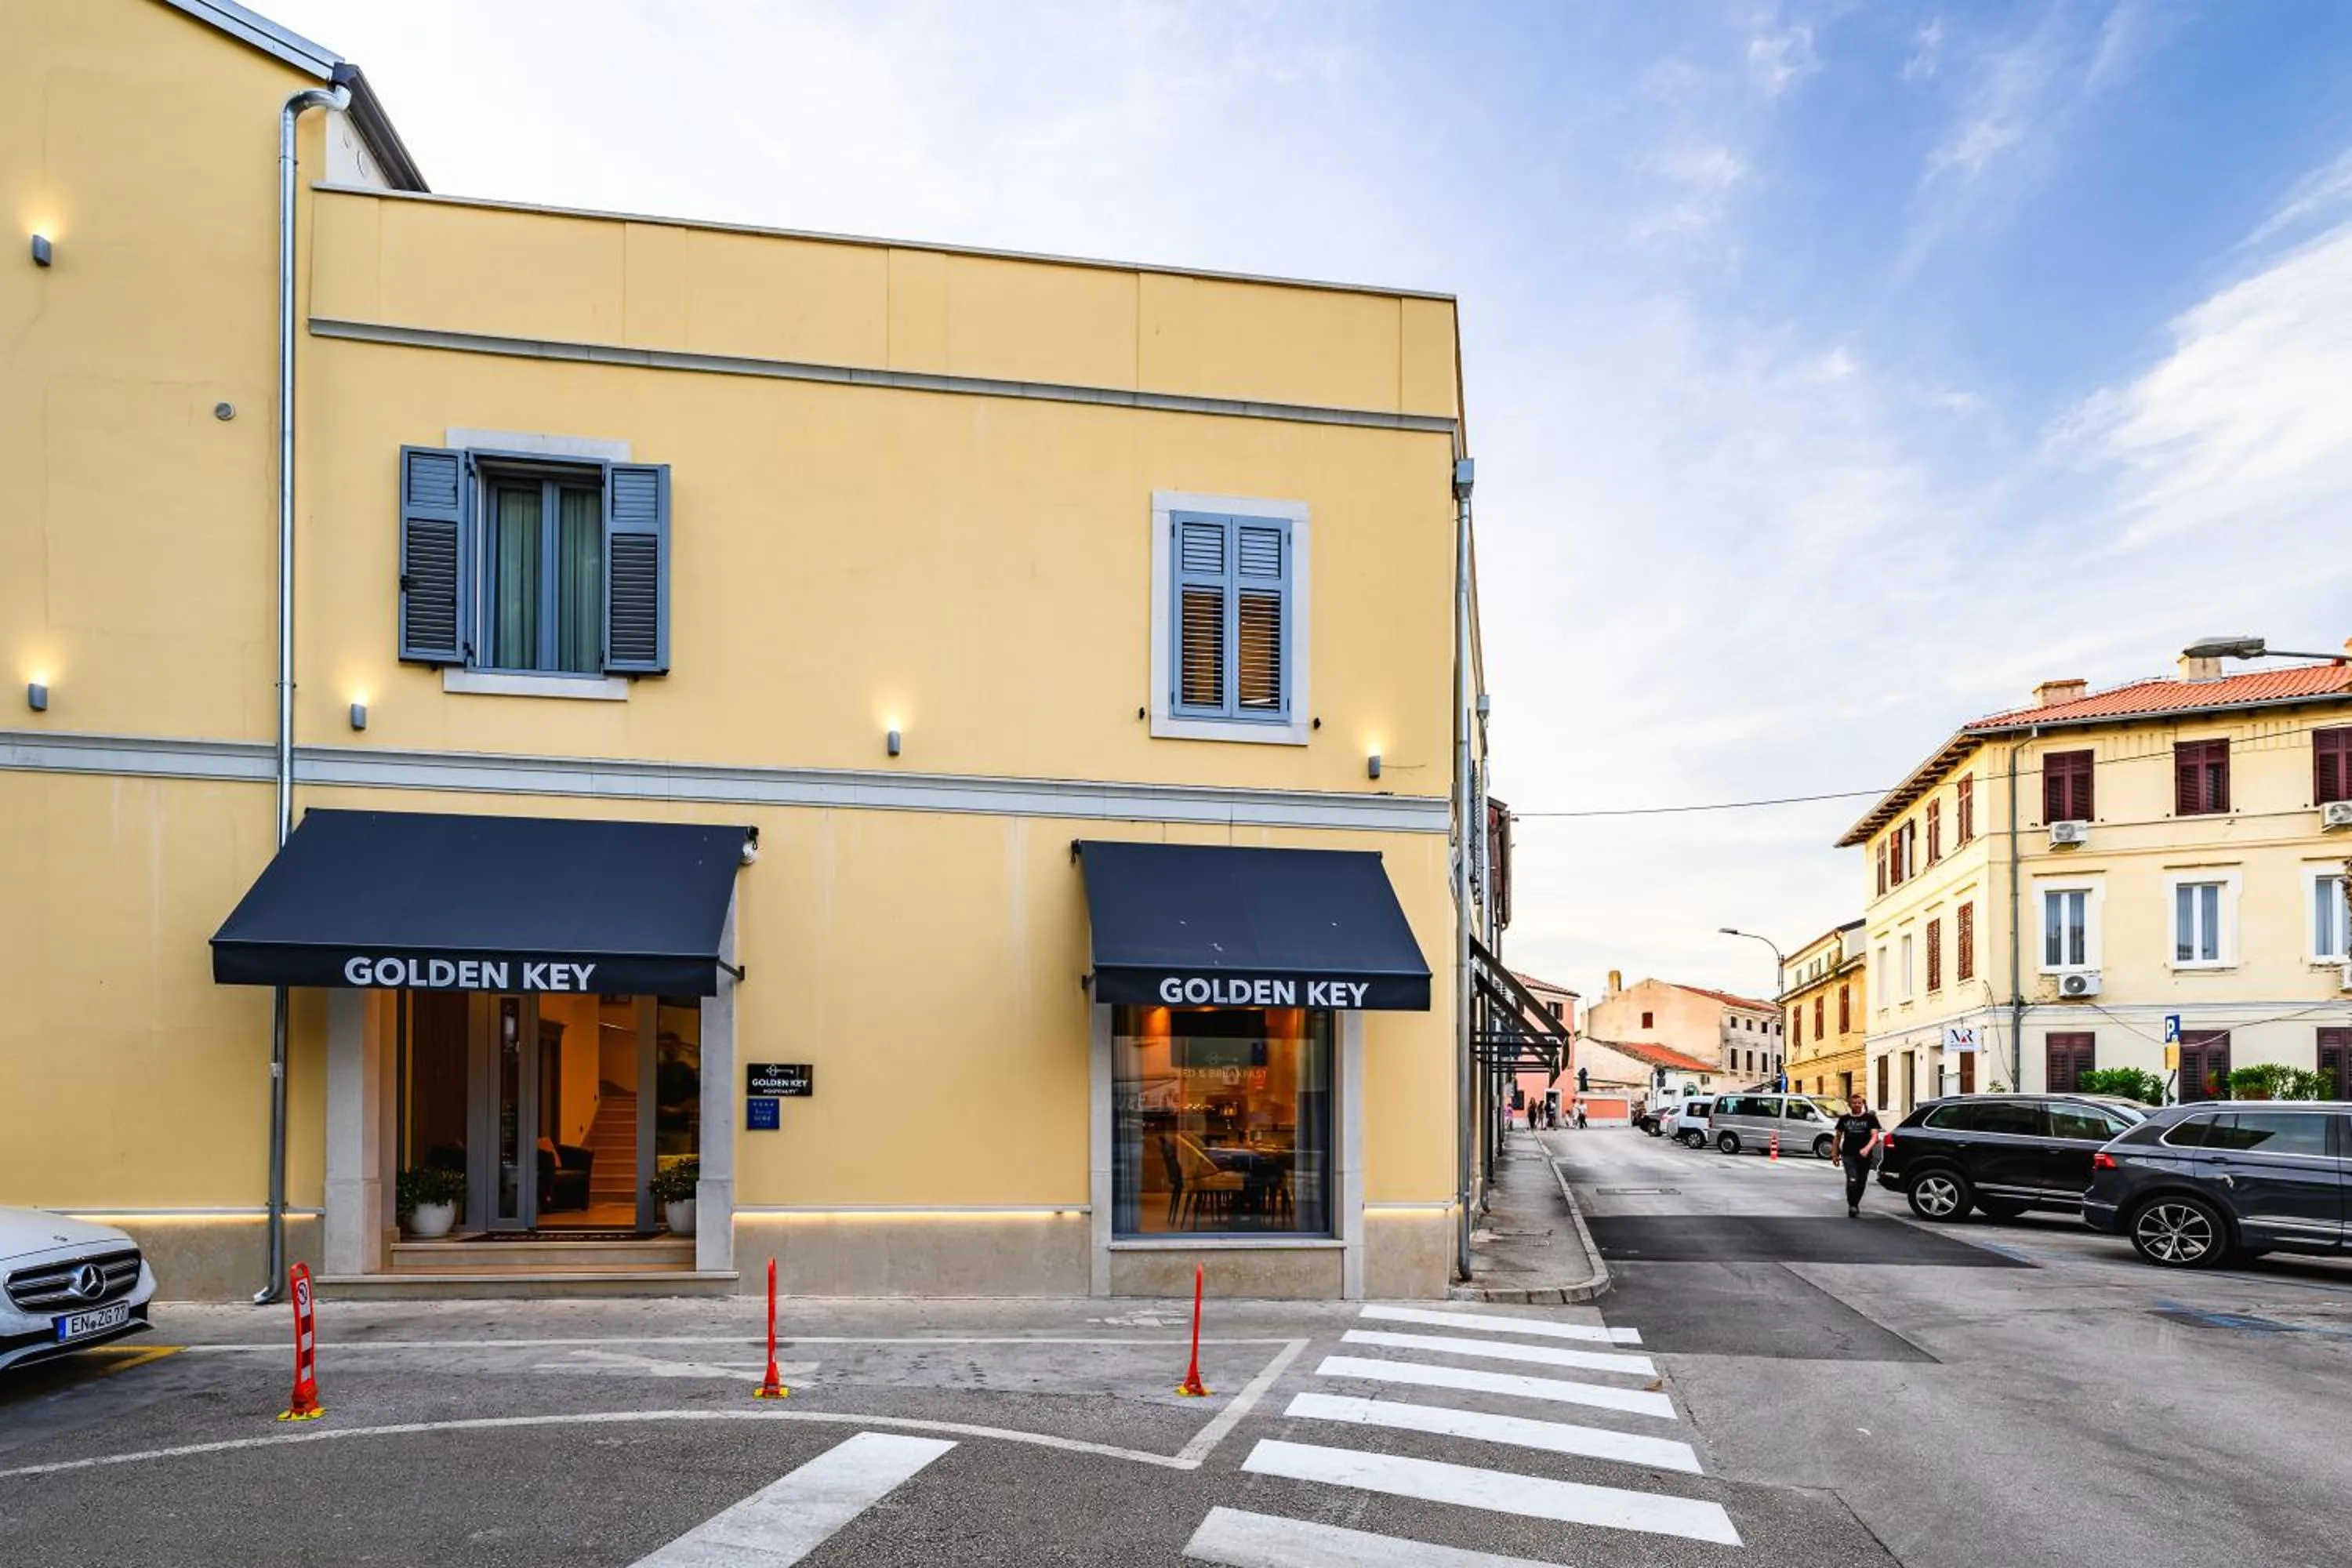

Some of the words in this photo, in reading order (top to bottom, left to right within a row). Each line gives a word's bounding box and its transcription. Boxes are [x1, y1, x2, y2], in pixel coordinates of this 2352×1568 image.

[344, 956, 509, 989] GOLDEN
[523, 962, 597, 991] KEY
[1160, 977, 1296, 1005] GOLDEN
[1307, 981, 1370, 1007] KEY
[2166, 1018, 2176, 1040] P
[752, 1078, 789, 1087] GOLDEN
[790, 1079, 808, 1087] KEY
